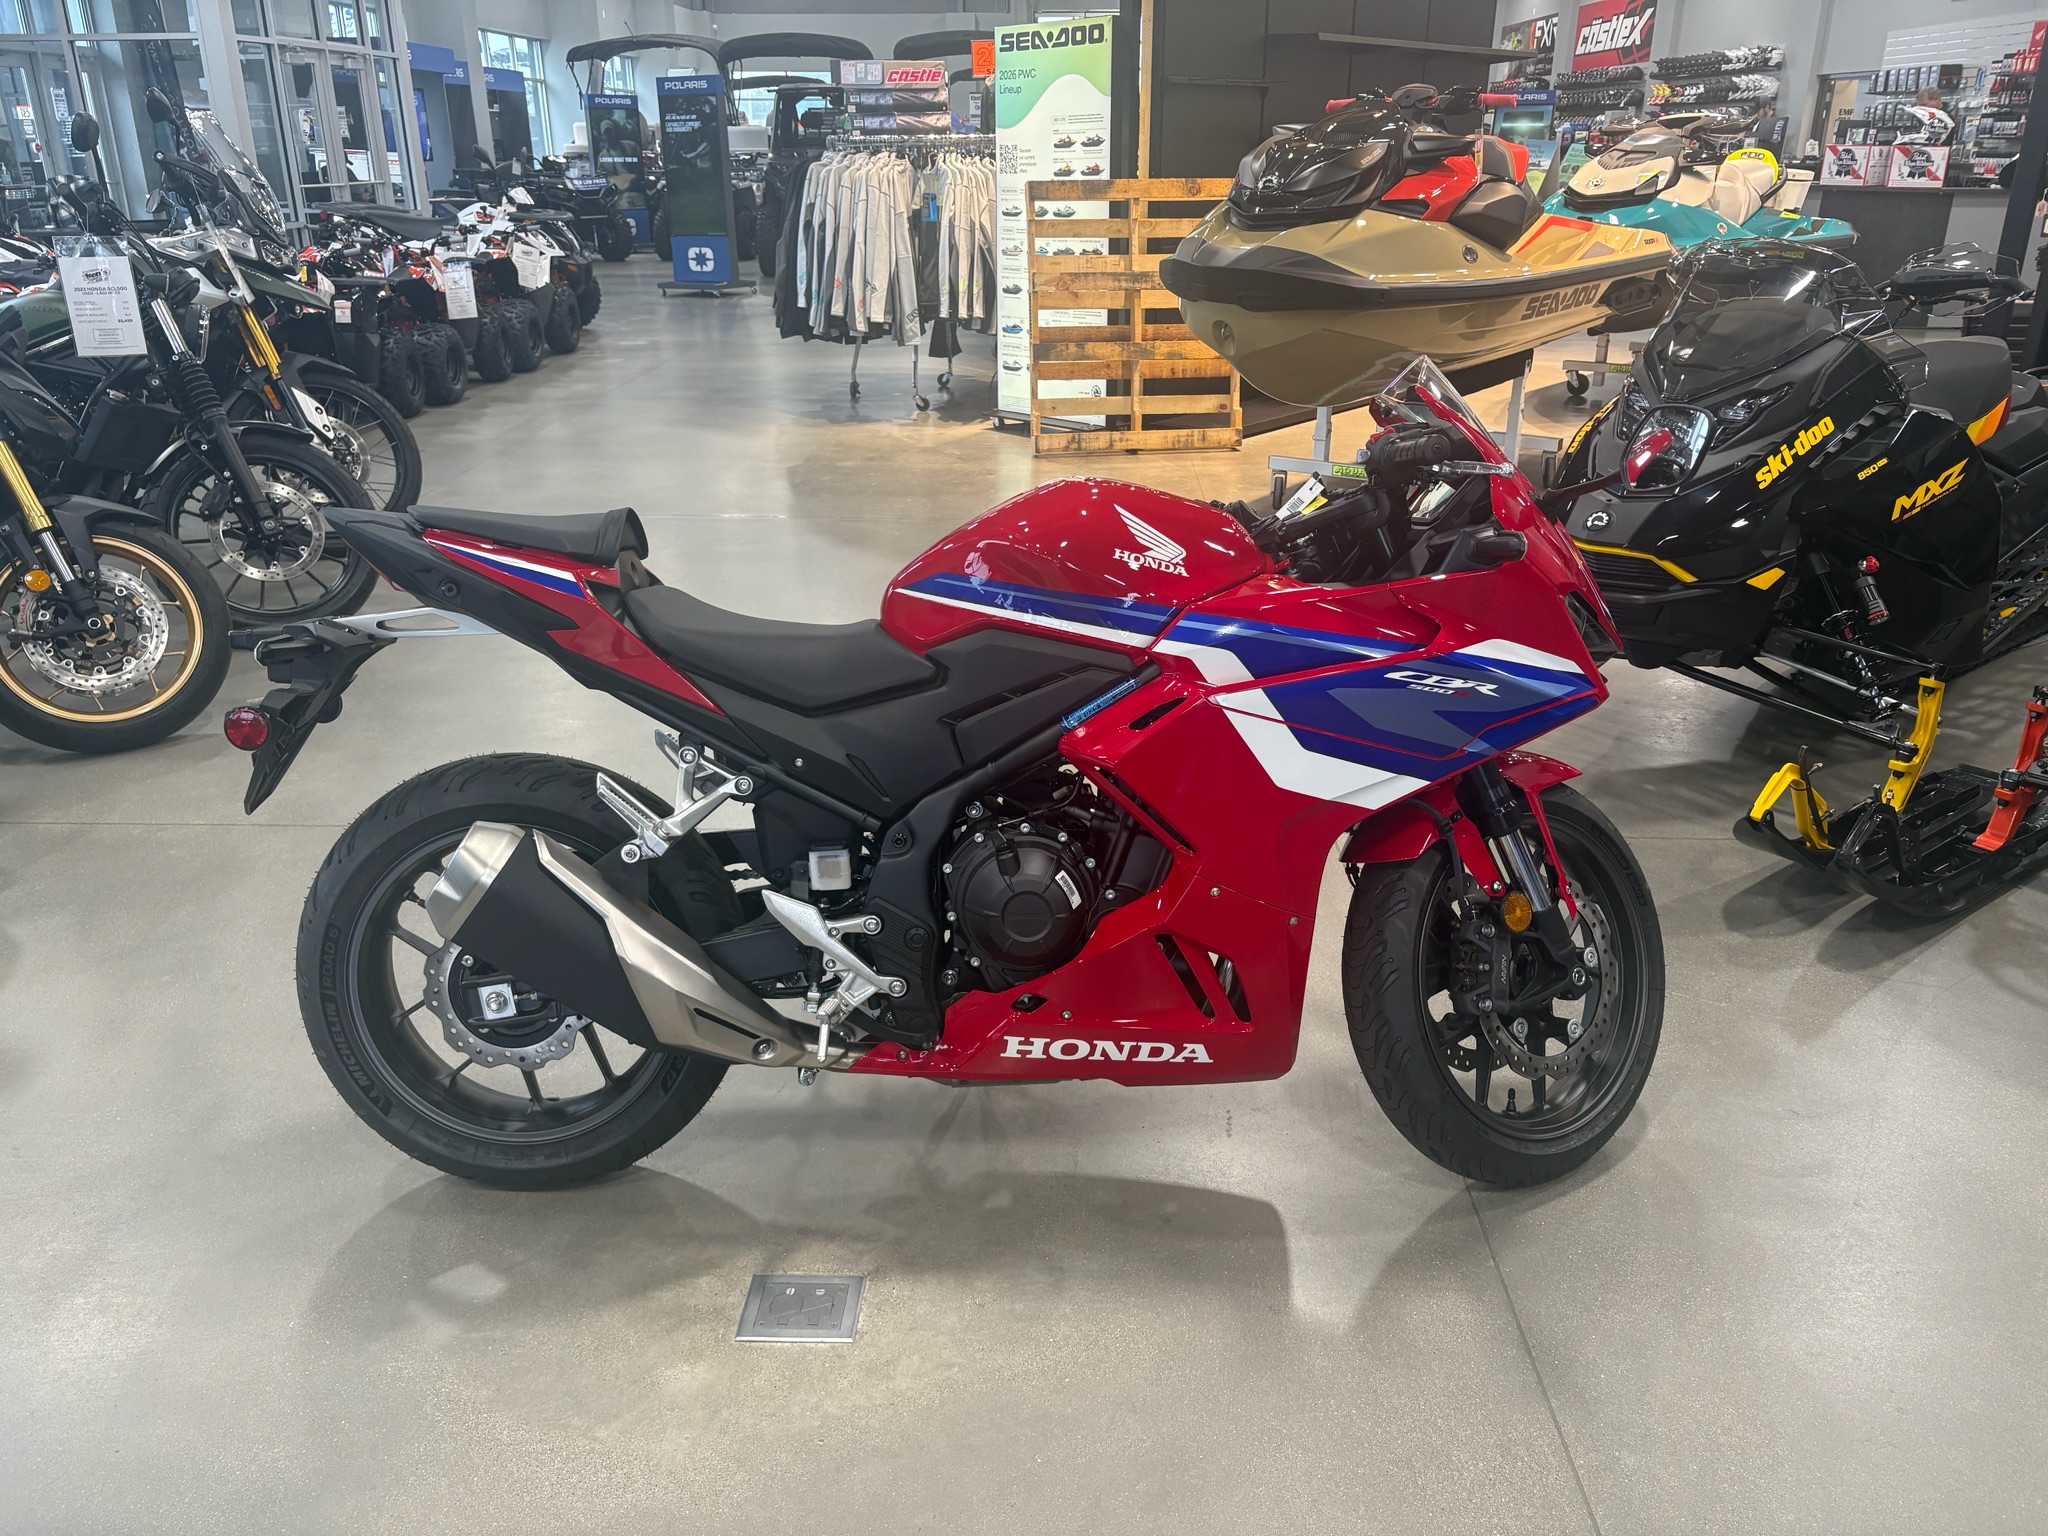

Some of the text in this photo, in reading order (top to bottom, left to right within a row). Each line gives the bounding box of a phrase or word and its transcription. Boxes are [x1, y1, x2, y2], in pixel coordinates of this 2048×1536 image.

[1000, 68, 1036, 80] 2026 PWC
[665, 80, 708, 90] POLARIS
[1000, 85, 1022, 96] Lineup
[595, 97, 632, 105] POLARIS
[1516, 93, 1548, 101] LARIS
[1857, 463, 1879, 481] 850
[1891, 457, 1970, 521] MXZ
[1112, 548, 1190, 577] HONDA
[1383, 670, 1501, 698] CBR
[1406, 684, 1471, 698] 500R
[322, 928, 339, 988] ROAD 6
[325, 1001, 372, 1088] MICHELIN
[1000, 1035, 1214, 1063] HONDA
